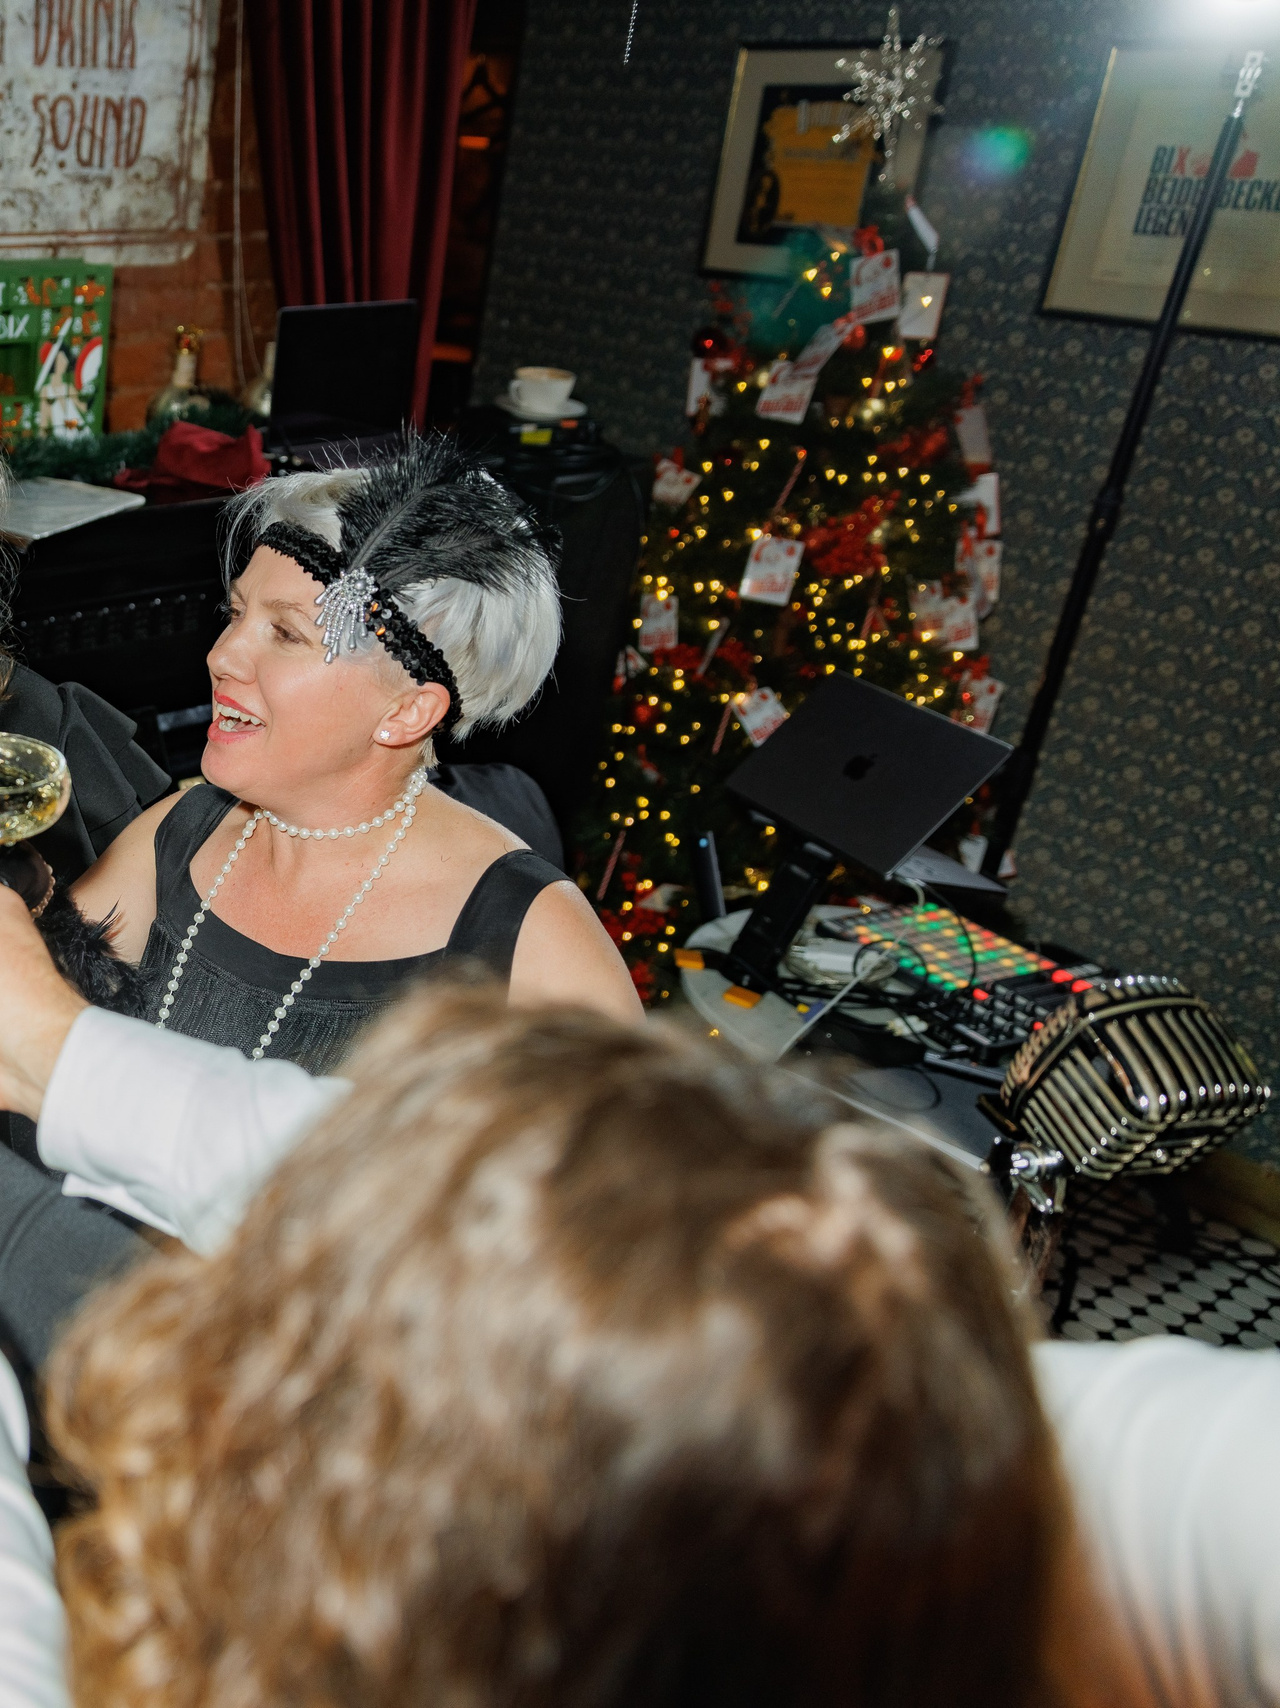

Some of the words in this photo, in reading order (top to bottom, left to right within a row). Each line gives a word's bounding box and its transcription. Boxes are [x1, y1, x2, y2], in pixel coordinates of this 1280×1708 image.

[34, 0, 138, 69] DRINK
[31, 92, 148, 170] SOUND
[1151, 146, 1190, 175] BIX
